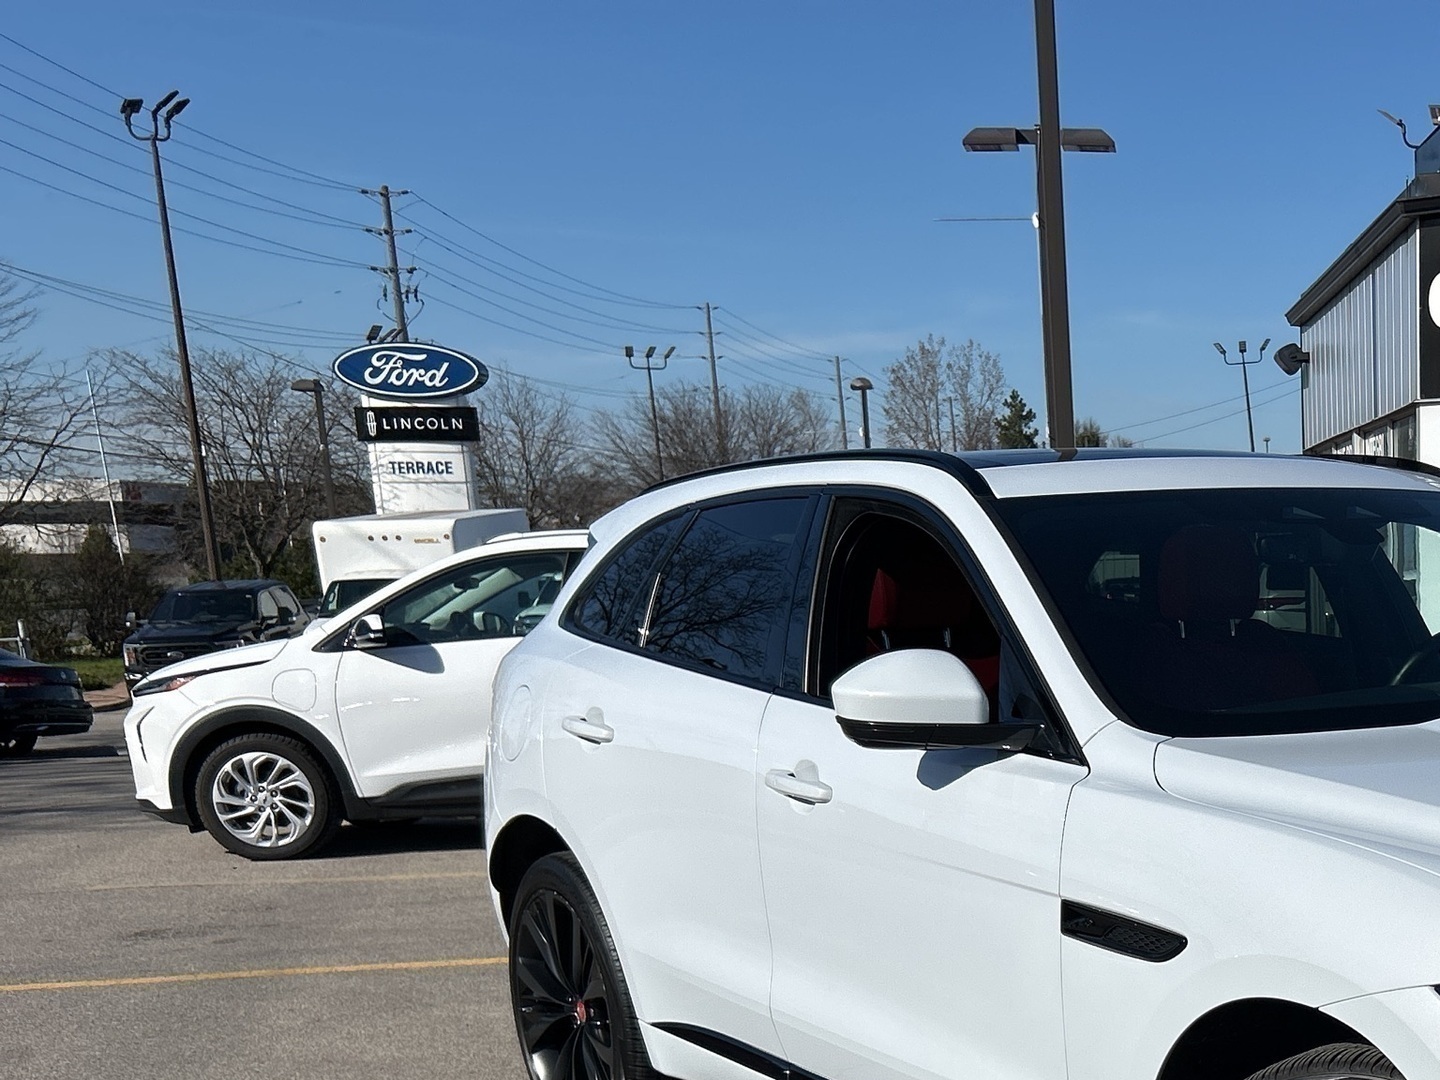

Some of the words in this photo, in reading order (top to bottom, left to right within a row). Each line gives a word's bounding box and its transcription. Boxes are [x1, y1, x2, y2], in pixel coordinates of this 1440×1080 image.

[364, 350, 450, 388] Ford
[382, 417, 463, 430] LINCOLN
[388, 461, 454, 475] TERRACE
